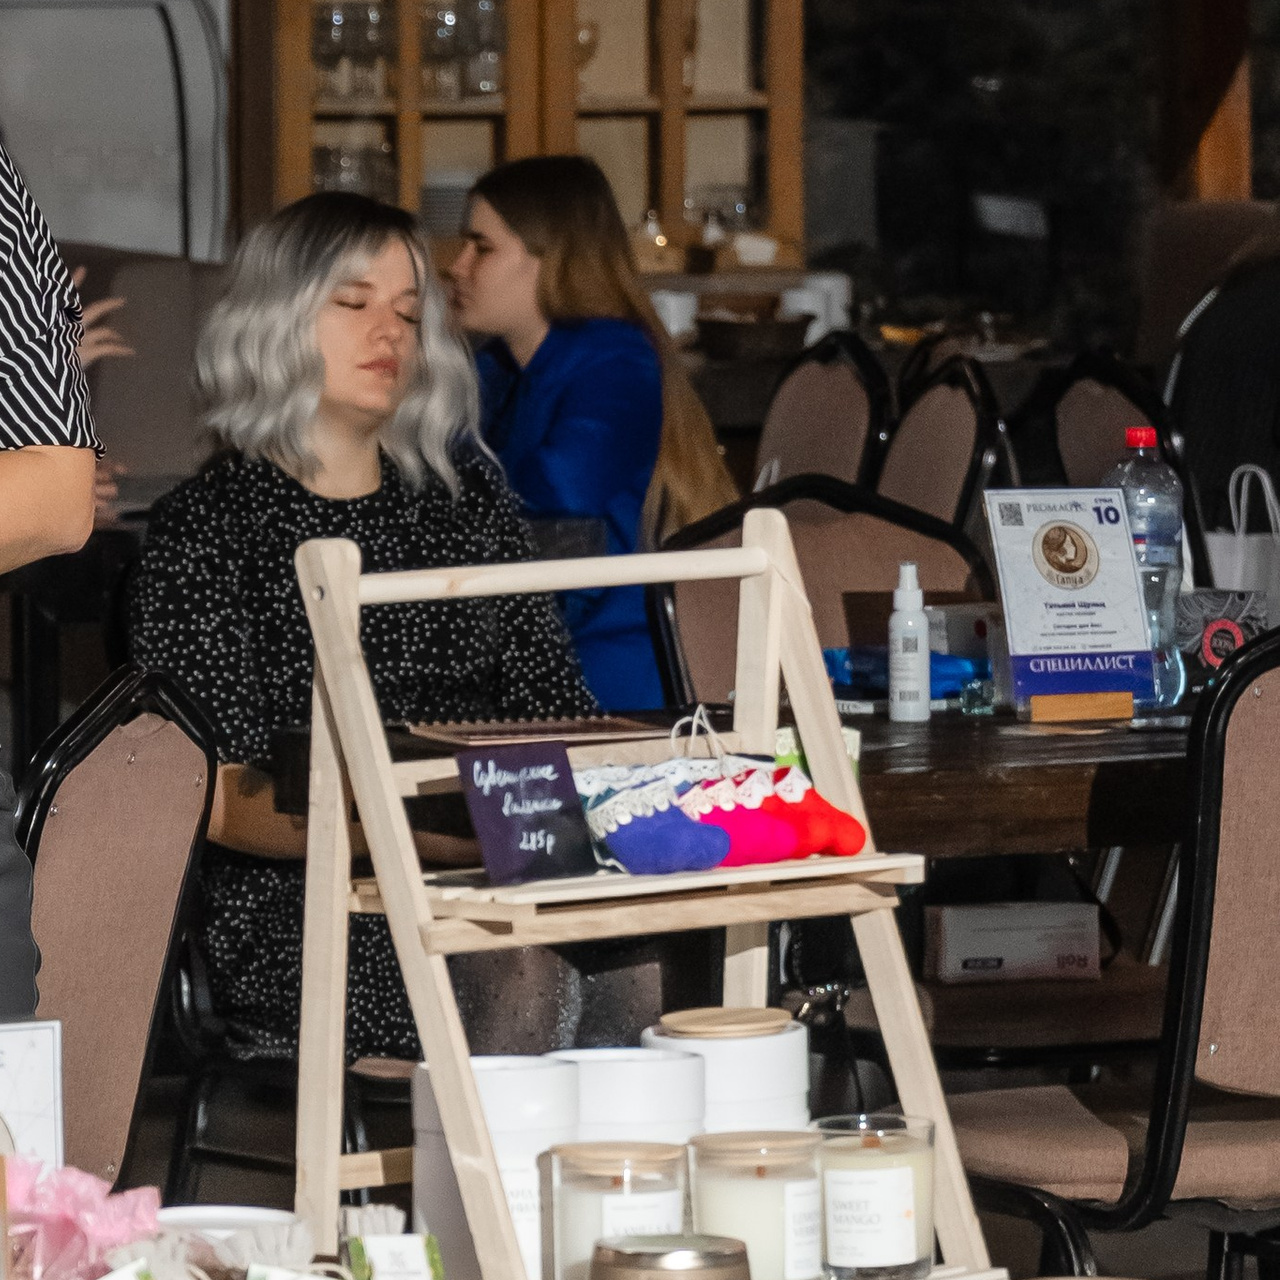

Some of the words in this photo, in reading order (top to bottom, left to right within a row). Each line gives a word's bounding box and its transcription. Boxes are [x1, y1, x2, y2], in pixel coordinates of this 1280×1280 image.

[1091, 505, 1120, 525] 10
[1029, 654, 1136, 673] СПЕЦИАЛИСТ
[832, 1213, 881, 1225] MANGO
